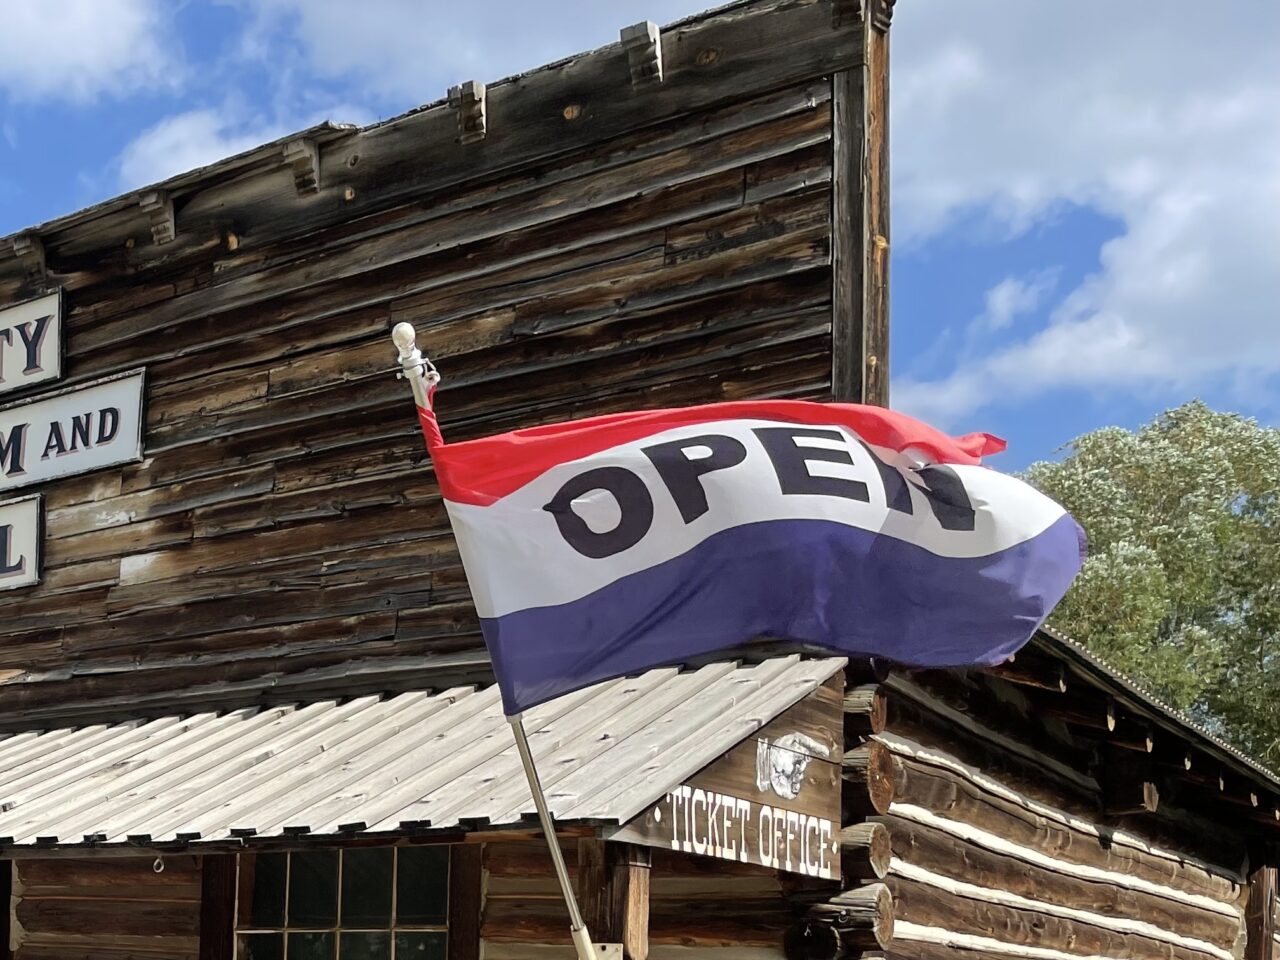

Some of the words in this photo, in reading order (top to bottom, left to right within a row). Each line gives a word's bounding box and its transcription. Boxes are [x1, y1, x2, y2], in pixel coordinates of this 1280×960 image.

[40, 407, 120, 460] AND
[542, 427, 975, 559] OPEN
[666, 784, 751, 864] TICKET
[759, 804, 832, 878] OFFICE
